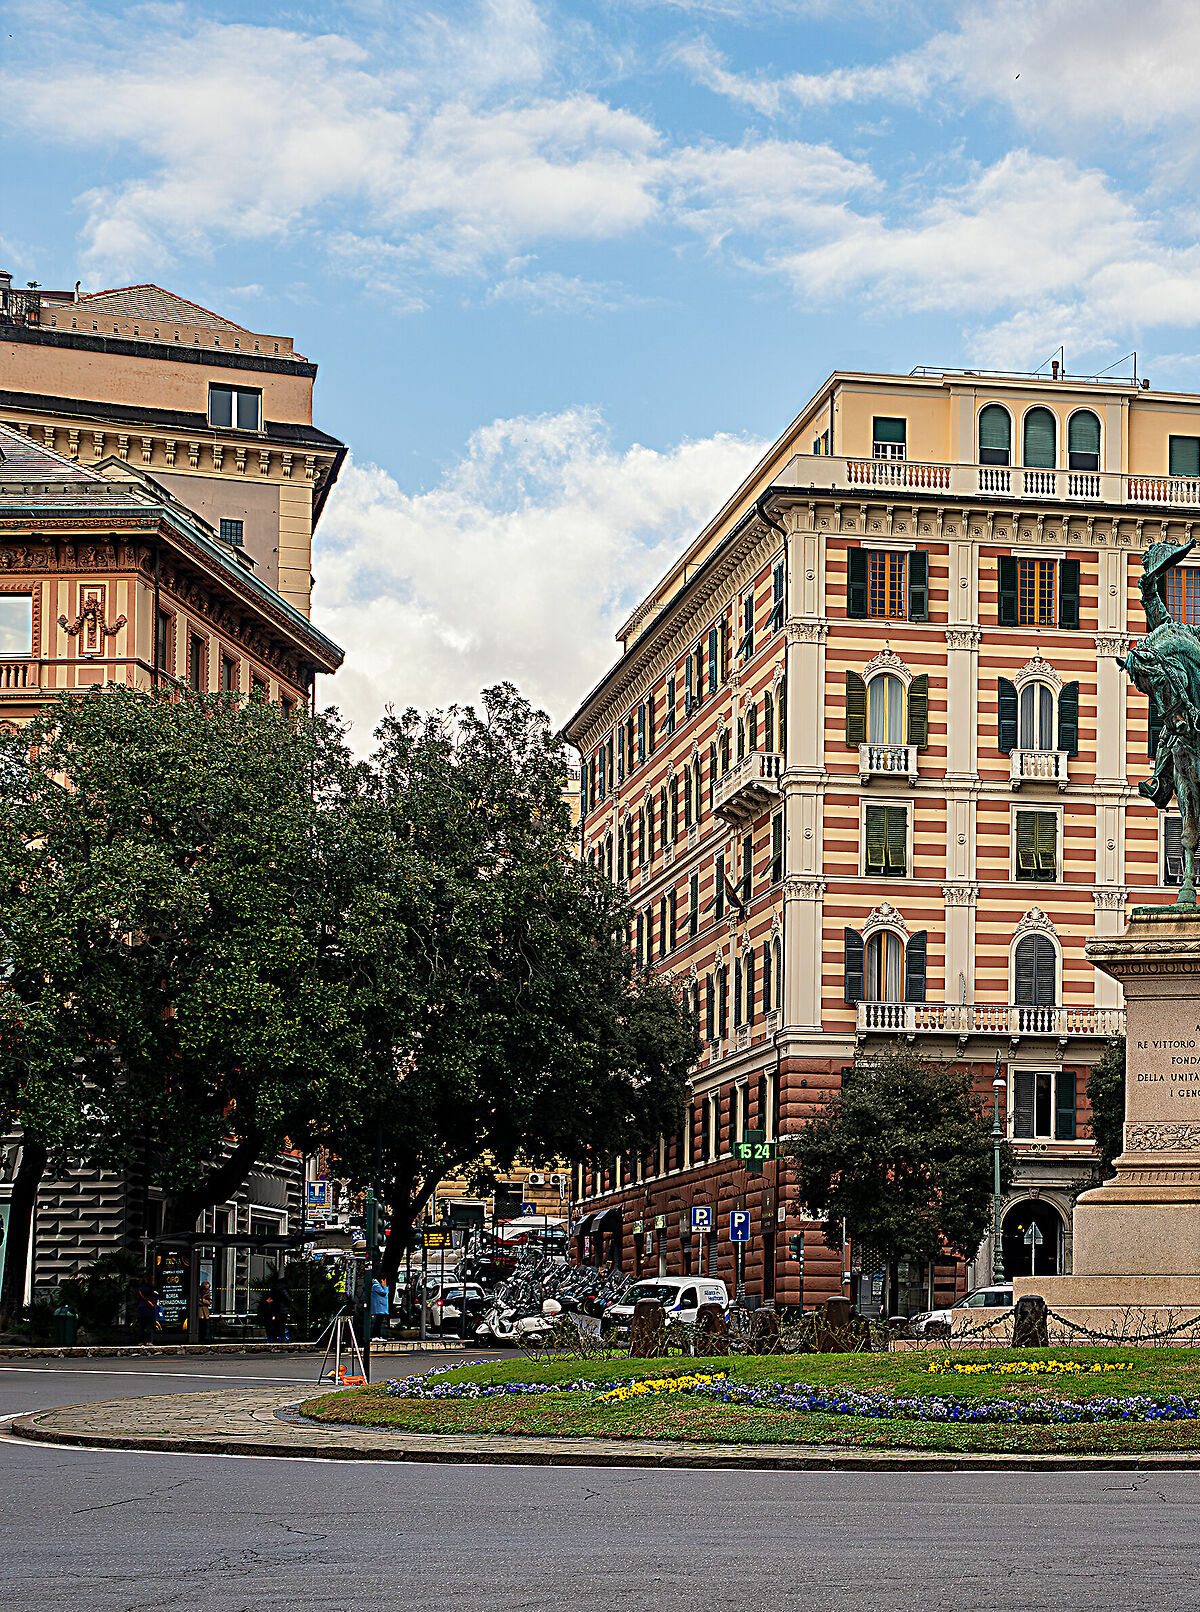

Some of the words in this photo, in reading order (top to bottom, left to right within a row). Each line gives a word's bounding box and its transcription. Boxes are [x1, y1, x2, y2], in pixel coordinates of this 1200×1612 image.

[1195, 1024, 1200, 1032] A
[1137, 1040, 1148, 1049] RE
[1152, 1040, 1196, 1048] VITTORIO
[1137, 1073, 1165, 1081] DELLA
[1170, 1072, 1200, 1081] UNITÀ
[738, 1143, 752, 1159] 15
[754, 1143, 770, 1159] 24
[310, 1183, 324, 1197] T
[695, 1208, 708, 1224] P
[734, 1212, 746, 1228] P
